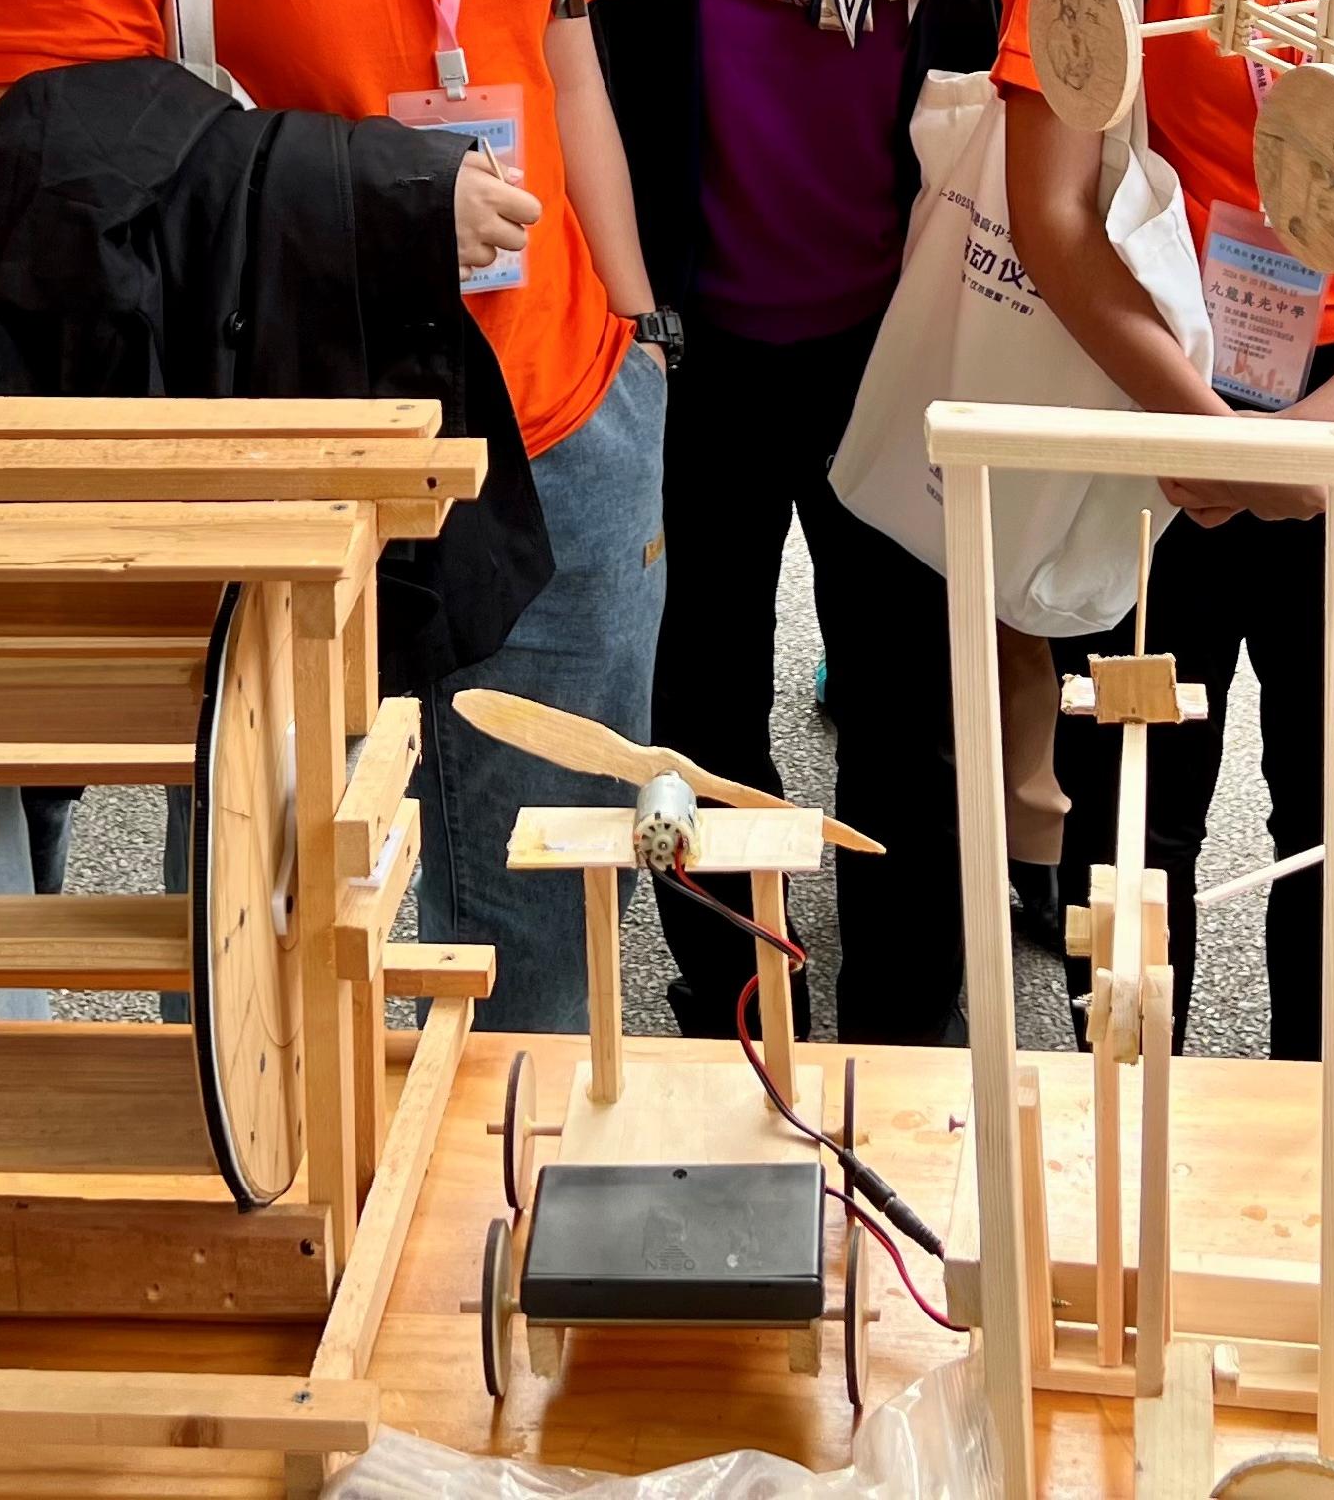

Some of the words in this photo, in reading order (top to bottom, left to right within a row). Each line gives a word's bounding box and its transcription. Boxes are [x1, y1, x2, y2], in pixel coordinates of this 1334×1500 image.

[1209, 281, 1306, 319] 九龍真光中學
